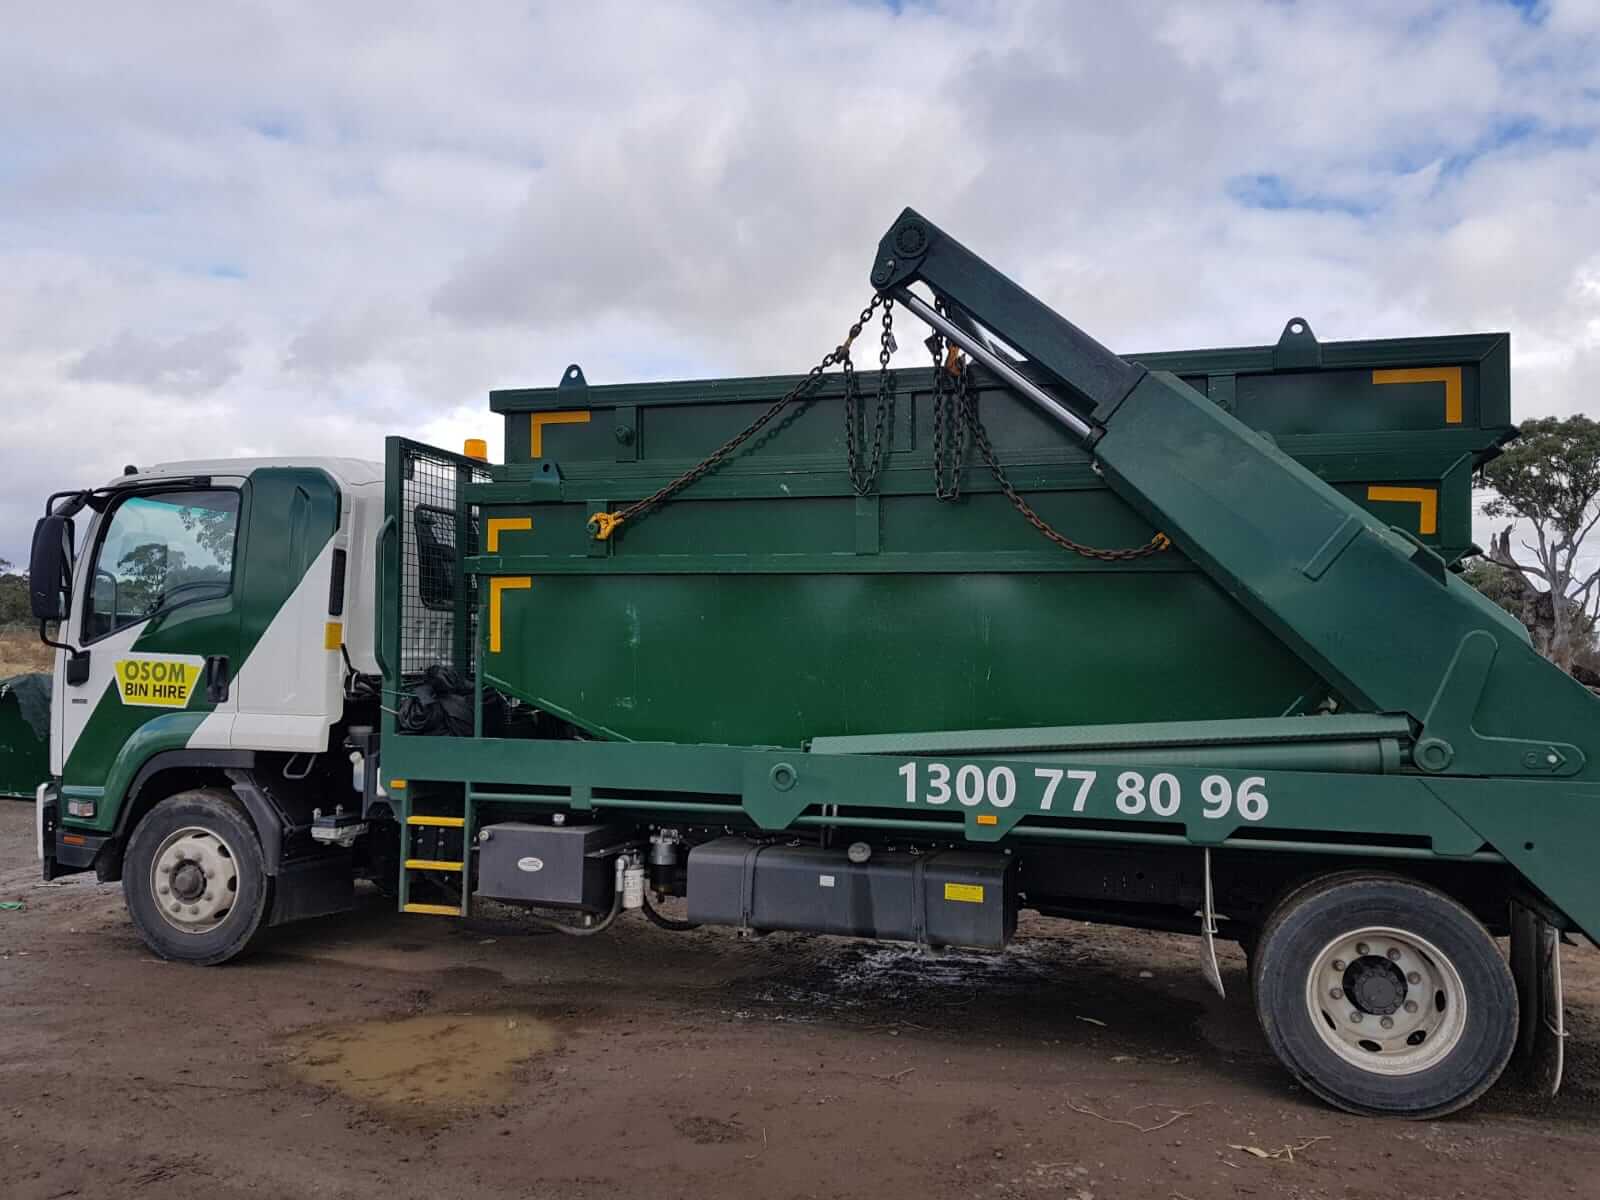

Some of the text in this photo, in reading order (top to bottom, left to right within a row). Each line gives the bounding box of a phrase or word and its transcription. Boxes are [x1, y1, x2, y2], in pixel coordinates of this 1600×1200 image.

[125, 661, 185, 682] OSOM
[125, 684, 187, 699] BIN HIRE
[898, 761, 1270, 821] 1300 77 80 96
